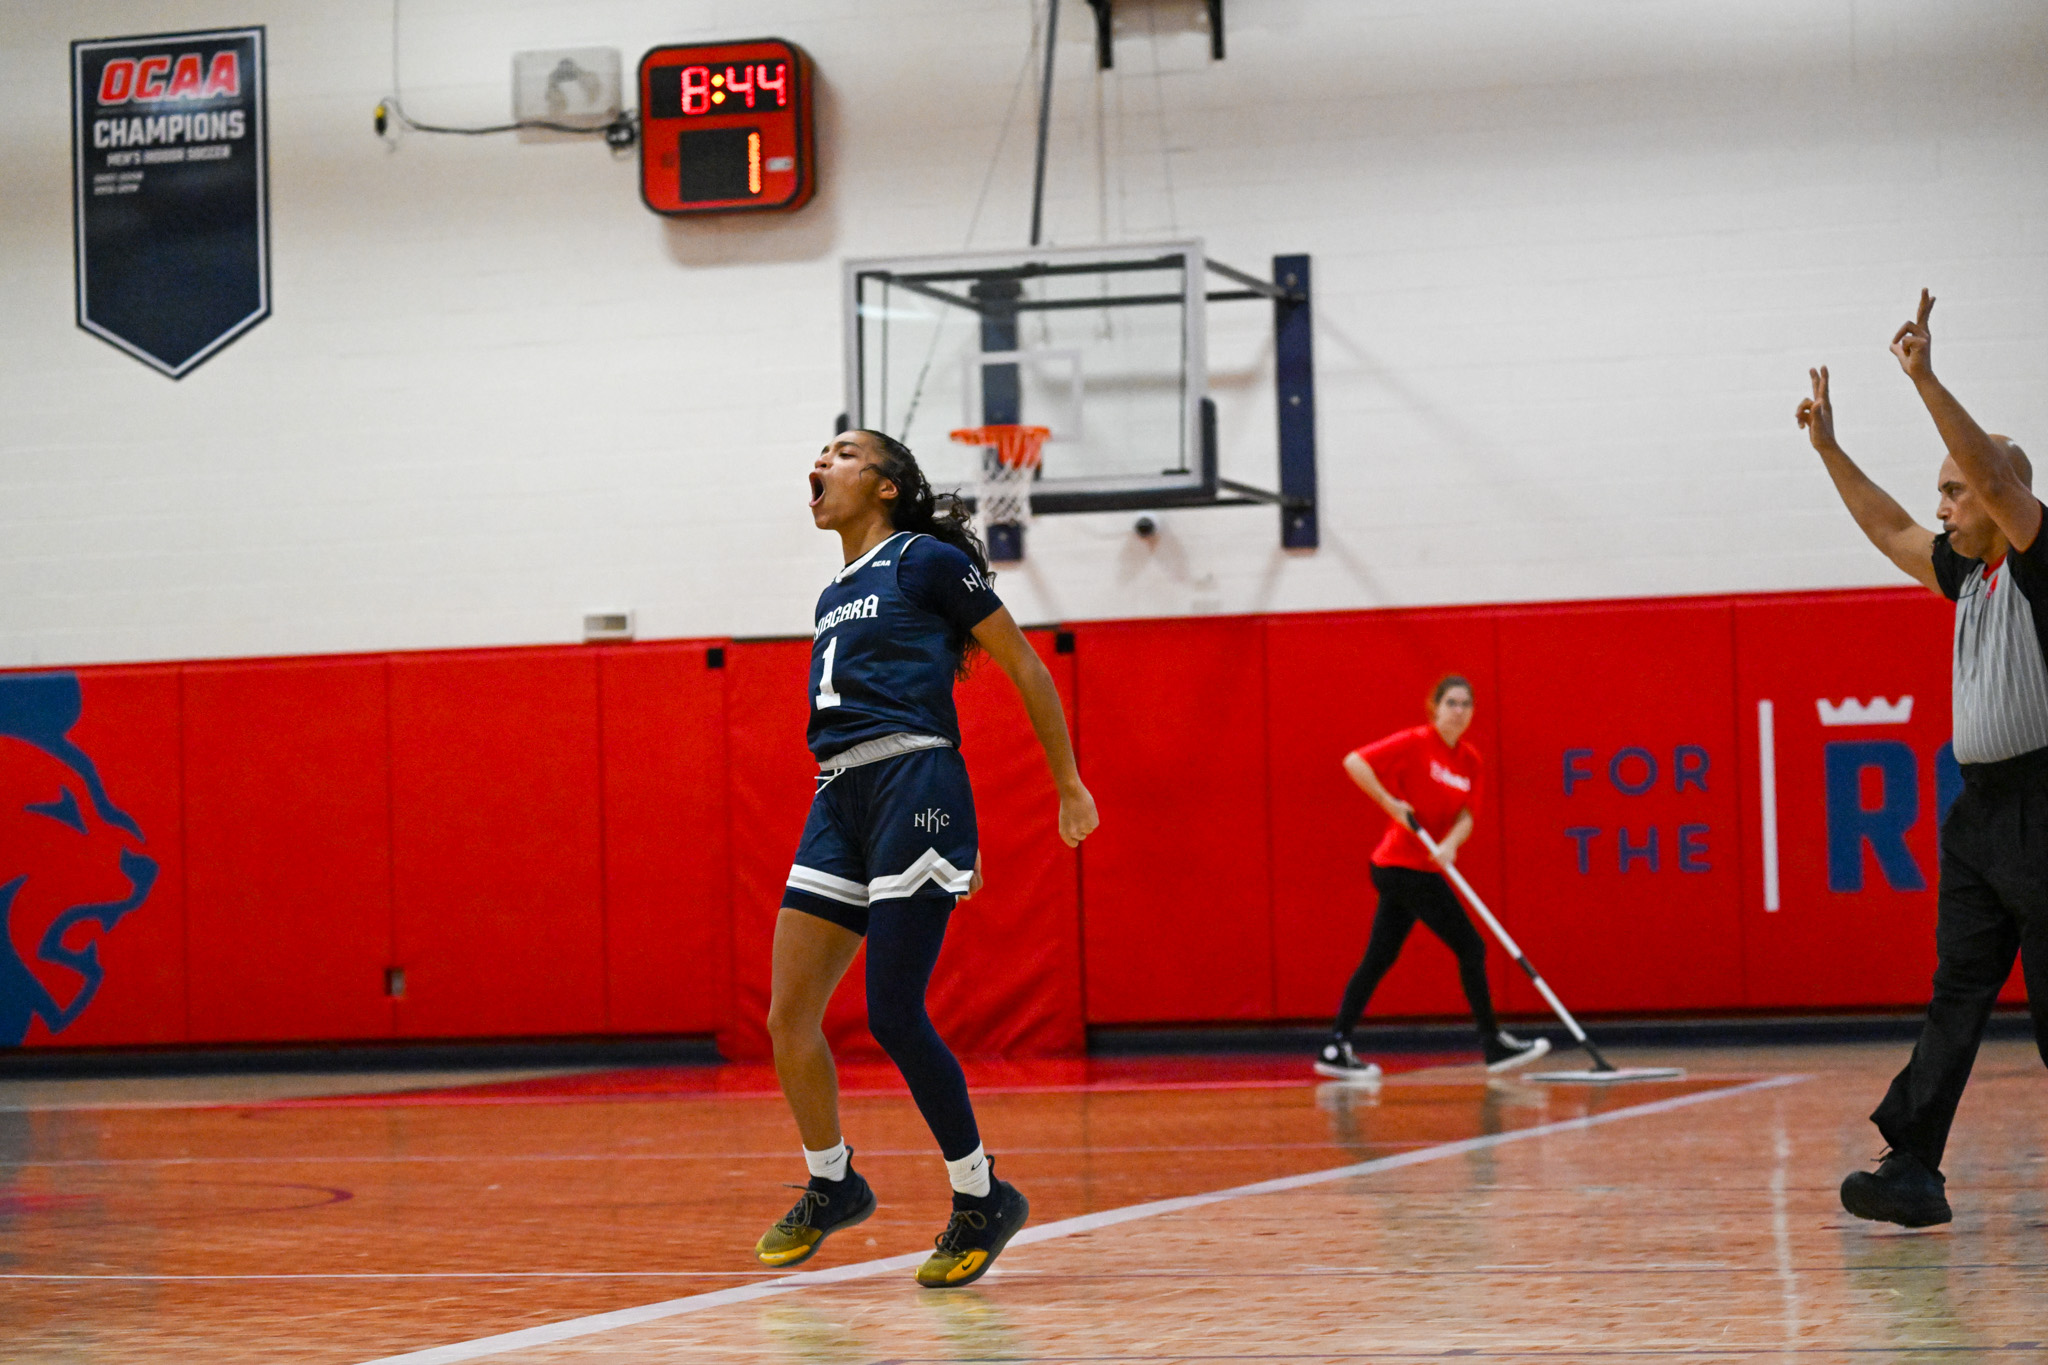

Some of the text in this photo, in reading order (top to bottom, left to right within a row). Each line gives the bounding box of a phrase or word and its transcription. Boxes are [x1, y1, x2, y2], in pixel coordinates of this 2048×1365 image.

[97, 51, 241, 104] OCAA
[681, 64, 786, 115] 8:44
[93, 109, 245, 148] CHAMPIONS
[748, 132, 761, 193] 1
[815, 636, 841, 710] 1
[1562, 744, 1711, 796] FOR
[914, 808, 950, 834] NKC
[1564, 823, 1711, 874] THE
